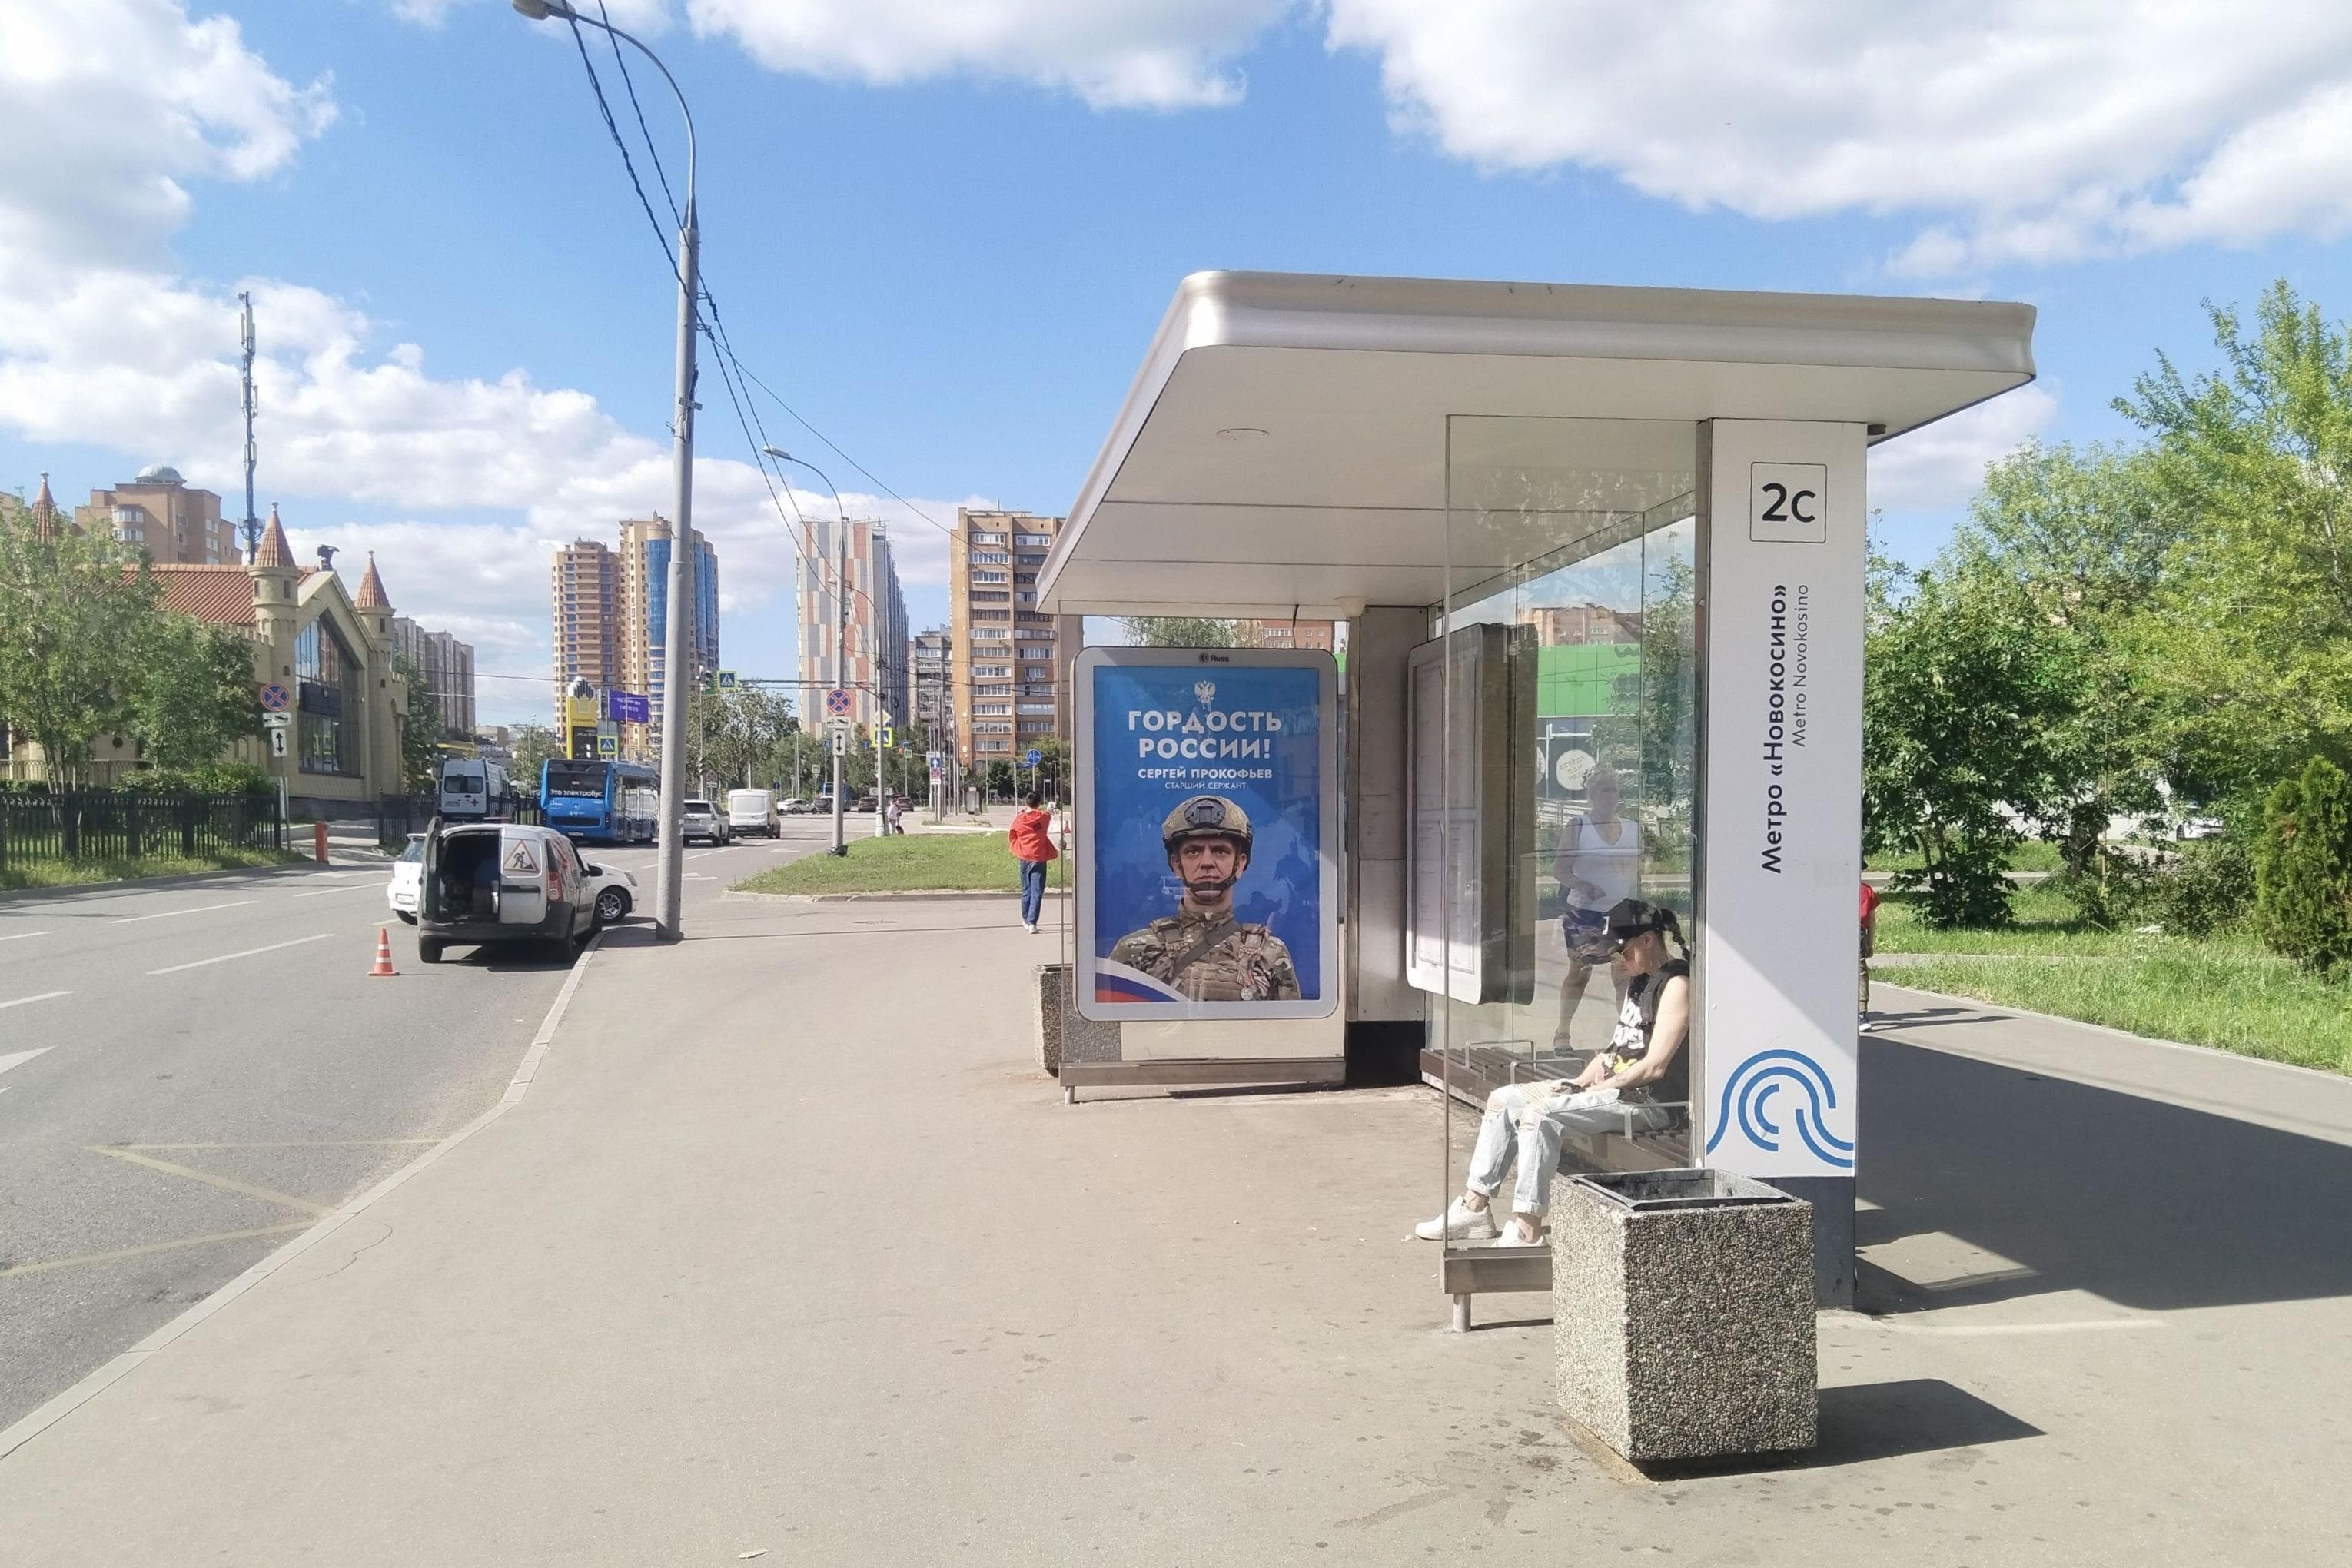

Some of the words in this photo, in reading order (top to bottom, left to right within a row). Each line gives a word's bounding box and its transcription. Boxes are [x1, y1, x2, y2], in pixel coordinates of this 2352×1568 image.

[1792, 584, 1809, 687] Novokosino
[1210, 654, 1230, 663] Russ
[1128, 710, 1282, 734] ГОРДОСТЬ
[1792, 693, 1807, 747] Metro
[1138, 737, 1271, 759] РОССИИ!
[1138, 766, 1186, 779] СЕРГЕЙ
[1191, 769, 1273, 779] ПРОКОФЬЕВ
[1164, 780, 1206, 790] СТАРШИЙ
[1208, 782, 1247, 790] СЕРЖАНТ
[1761, 783, 1788, 874] Метро
